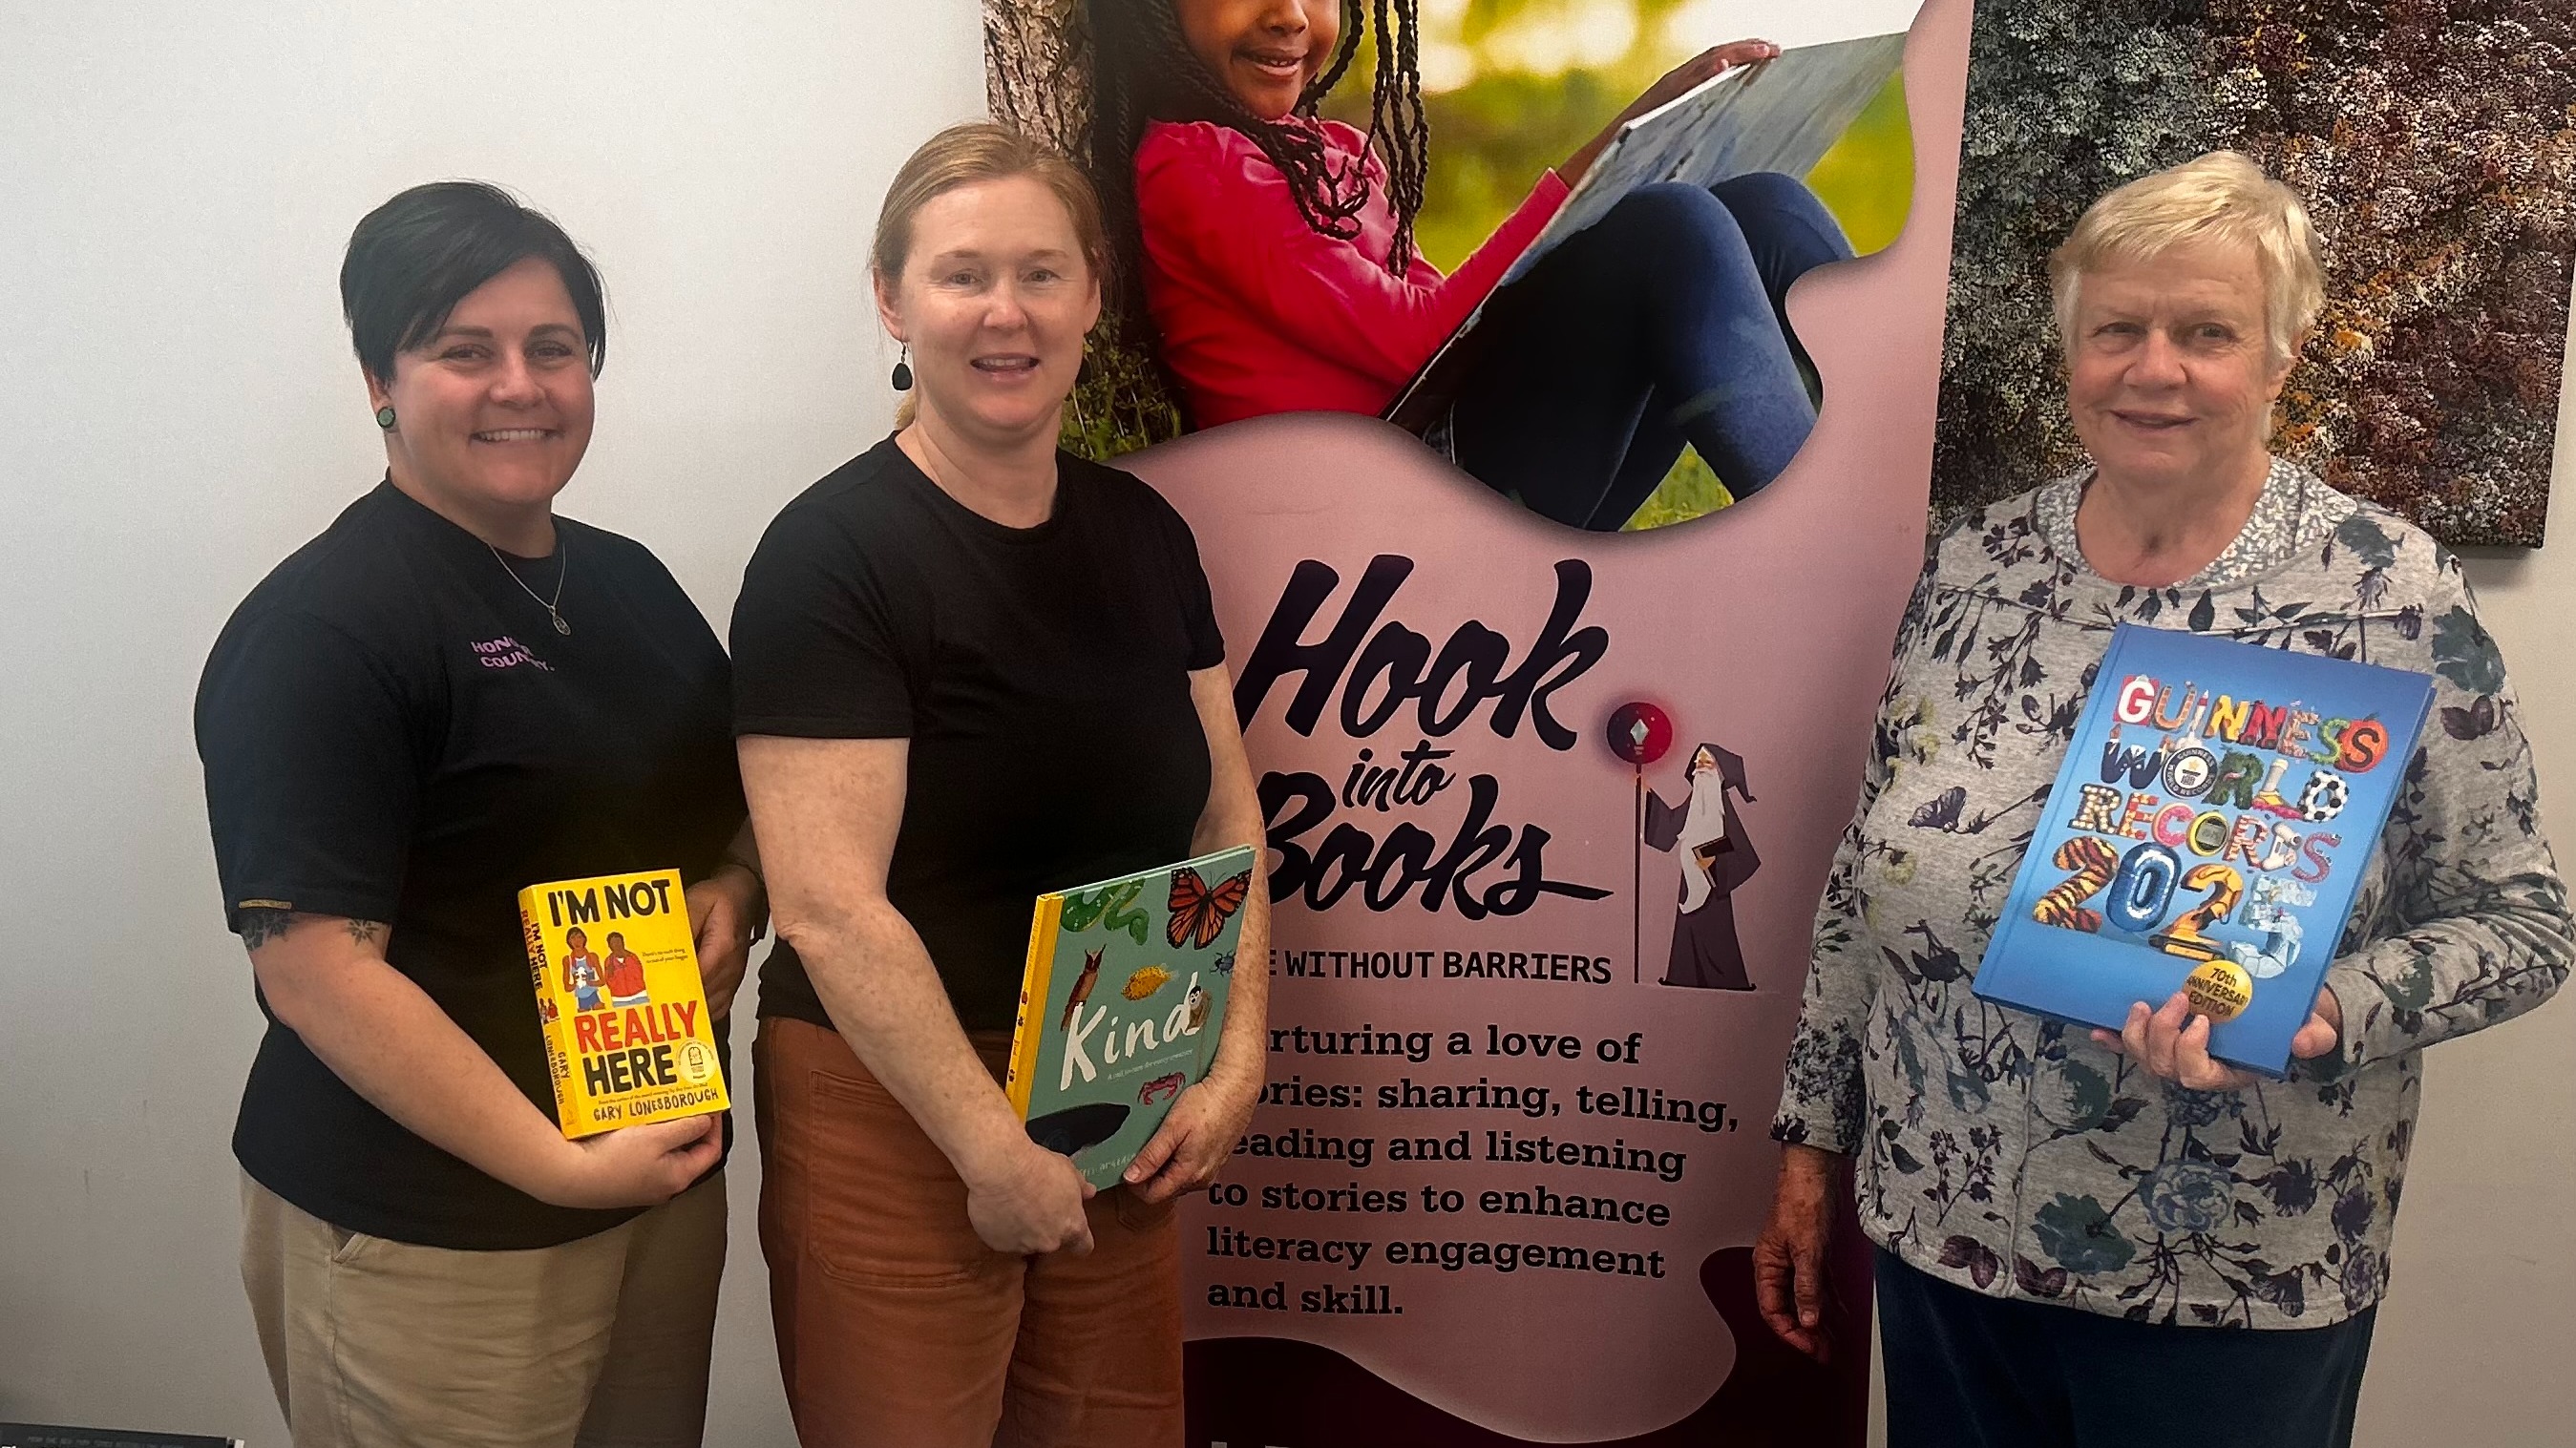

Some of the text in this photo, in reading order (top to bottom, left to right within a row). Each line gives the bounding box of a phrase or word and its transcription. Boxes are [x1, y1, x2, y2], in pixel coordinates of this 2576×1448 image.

[1233, 554, 1609, 751] Hook
[2113, 675, 2389, 774] GUINNESS
[1341, 740, 1455, 812] into
[2100, 729, 2349, 823] WORLD
[1255, 770, 1615, 920] Books
[2067, 784, 2342, 884] RECORDS
[547, 878, 670, 927] I'M NOT
[2031, 835, 2318, 979] 2025
[529, 956, 543, 990] HERE
[535, 943, 548, 969] NOT
[1285, 949, 1435, 980] WITHOUT
[1442, 953, 1612, 985] BARRIERS
[2210, 967, 2237, 988] 70th
[574, 1000, 697, 1054] REALLY
[2189, 991, 2235, 1017] EDITION
[1060, 971, 1203, 1092] Kind
[1266, 1023, 1643, 1065] rturing a love of
[582, 1044, 678, 1097] HERE
[593, 1104, 622, 1122] GARY
[628, 1088, 719, 1117] LONESBOROUGH
[1377, 1077, 1561, 1118] sharing,
[1575, 1084, 1739, 1134] telling,
[1232, 1128, 1687, 1183] eading and listening
[1208, 1182, 1671, 1227] to stories to enhance
[1206, 1226, 1666, 1279] literacy engagement
[1207, 1281, 1404, 1315] and skill.
